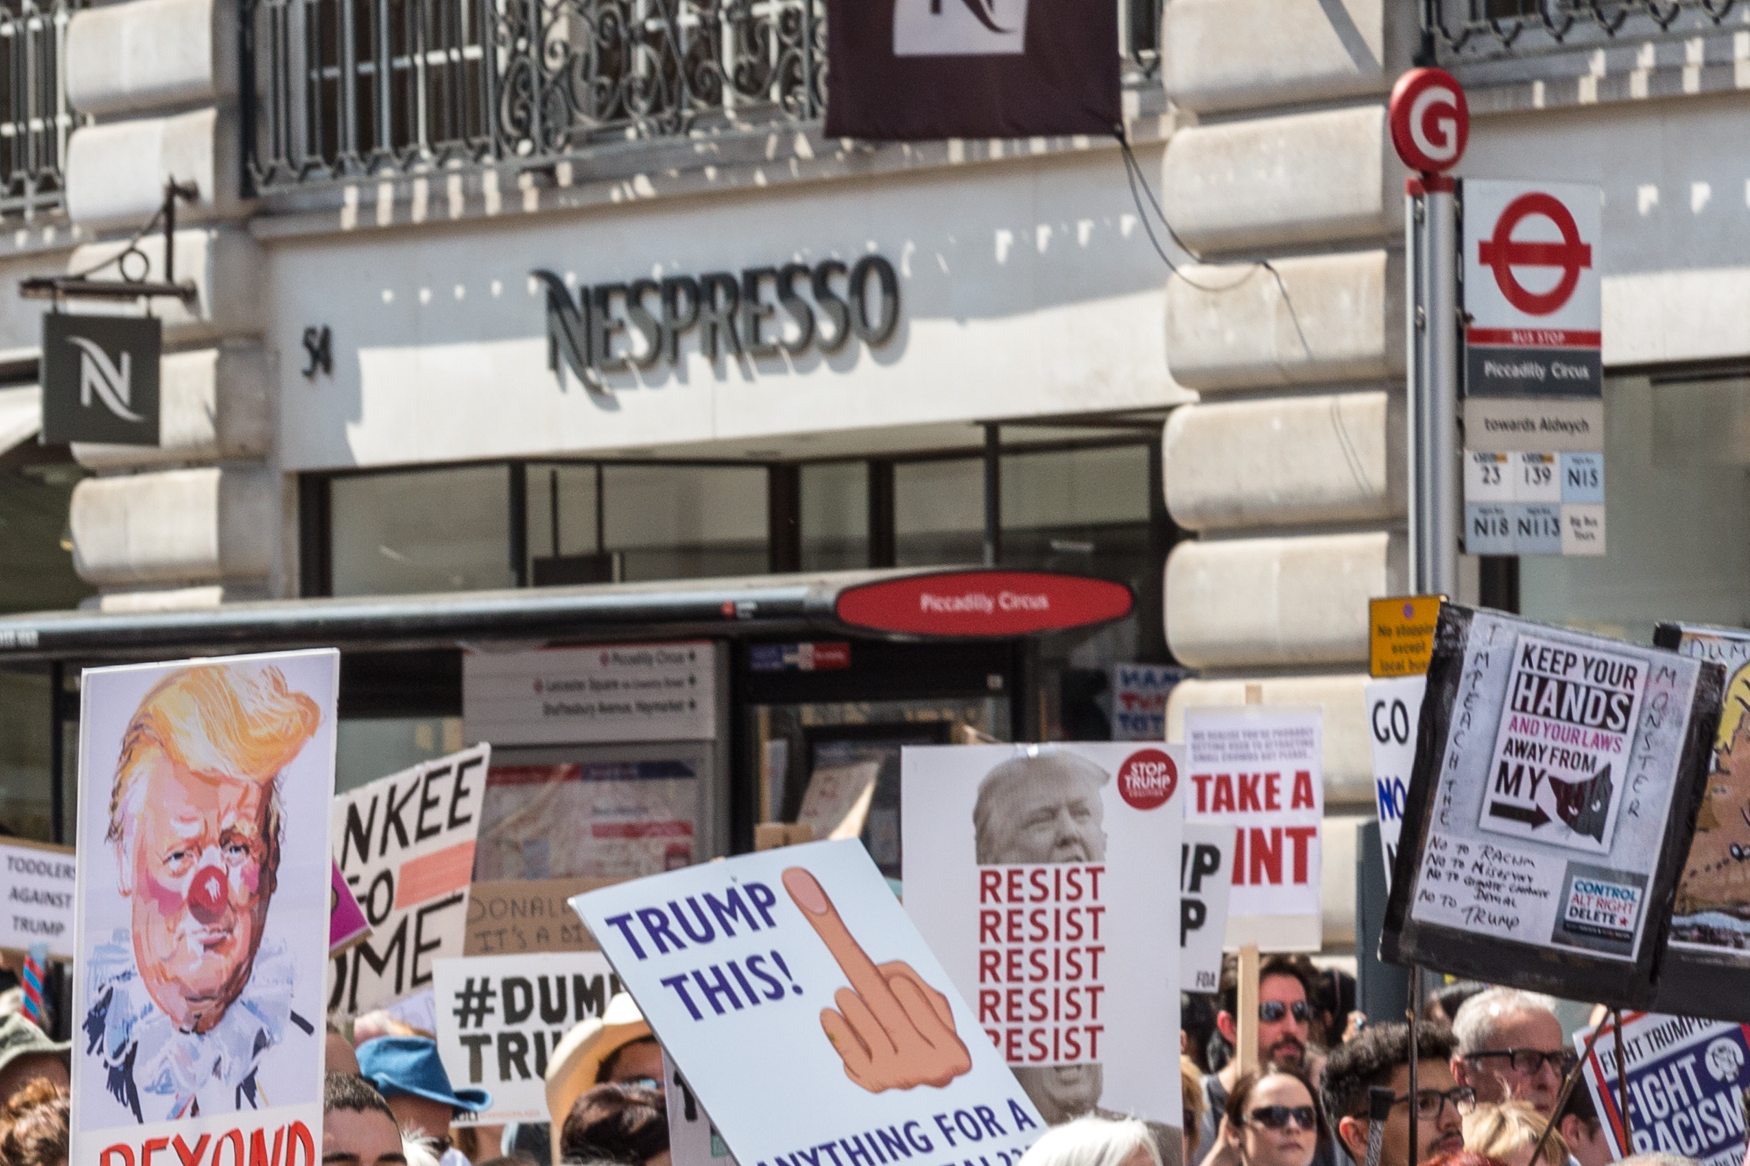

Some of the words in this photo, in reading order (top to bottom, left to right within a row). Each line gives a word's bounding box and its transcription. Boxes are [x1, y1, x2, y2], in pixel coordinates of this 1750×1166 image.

[1410, 86, 1457, 161] G
[531, 254, 898, 396] NESPRESSO
[65, 336, 145, 422] N
[1484, 361, 1546, 382] Piccadilly
[1551, 361, 1590, 379] Circus
[1484, 418, 1536, 431] towards
[1540, 417, 1589, 435] Aldwych
[1481, 465, 1501, 485] 23
[1523, 465, 1552, 485] 139
[1568, 467, 1598, 487] N15
[1474, 517, 1509, 537] N18
[1517, 516, 1561, 537] N113
[920, 593, 994, 614] Piccadilly
[999, 590, 1049, 611] Circus
[1521, 643, 1578, 679] KEEP
[1581, 656, 1639, 691] YOUR
[1372, 699, 1409, 744] GO
[1512, 672, 1634, 733] HANDS
[1509, 715, 1540, 738] AND
[1541, 721, 1582, 747] YOUR
[1583, 729, 1623, 754] LAWS
[1130, 761, 1166, 778] STOP
[1503, 737, 1549, 764] AWAY
[1550, 746, 1597, 773] FROM
[1124, 775, 1171, 790] TRUMP
[1191, 772, 1281, 813] TAKE
[1291, 770, 1315, 809] A
[1495, 761, 1547, 802] MY
[341, 756, 483, 871] NKEE
[1232, 826, 1316, 886] INT
[9, 887, 72, 908] AGAINST
[979, 866, 1106, 904] RESIST
[1571, 893, 1593, 908] ALT
[1595, 899, 1635, 915] RIGHT
[1574, 880, 1637, 902] CONTROL
[13, 915, 65, 936] TRUMP
[604, 882, 777, 961] TRUMP
[979, 906, 1106, 944] RESIST
[1569, 906, 1617, 925] DELETE
[979, 946, 1106, 984] RESIST
[1196, 971, 1215, 988] FOA
[660, 950, 803, 1021] THIS!
[978, 985, 1105, 1023] RESIST
[933, 1105, 1006, 1148] FOR
[1007, 1098, 1037, 1131] A
